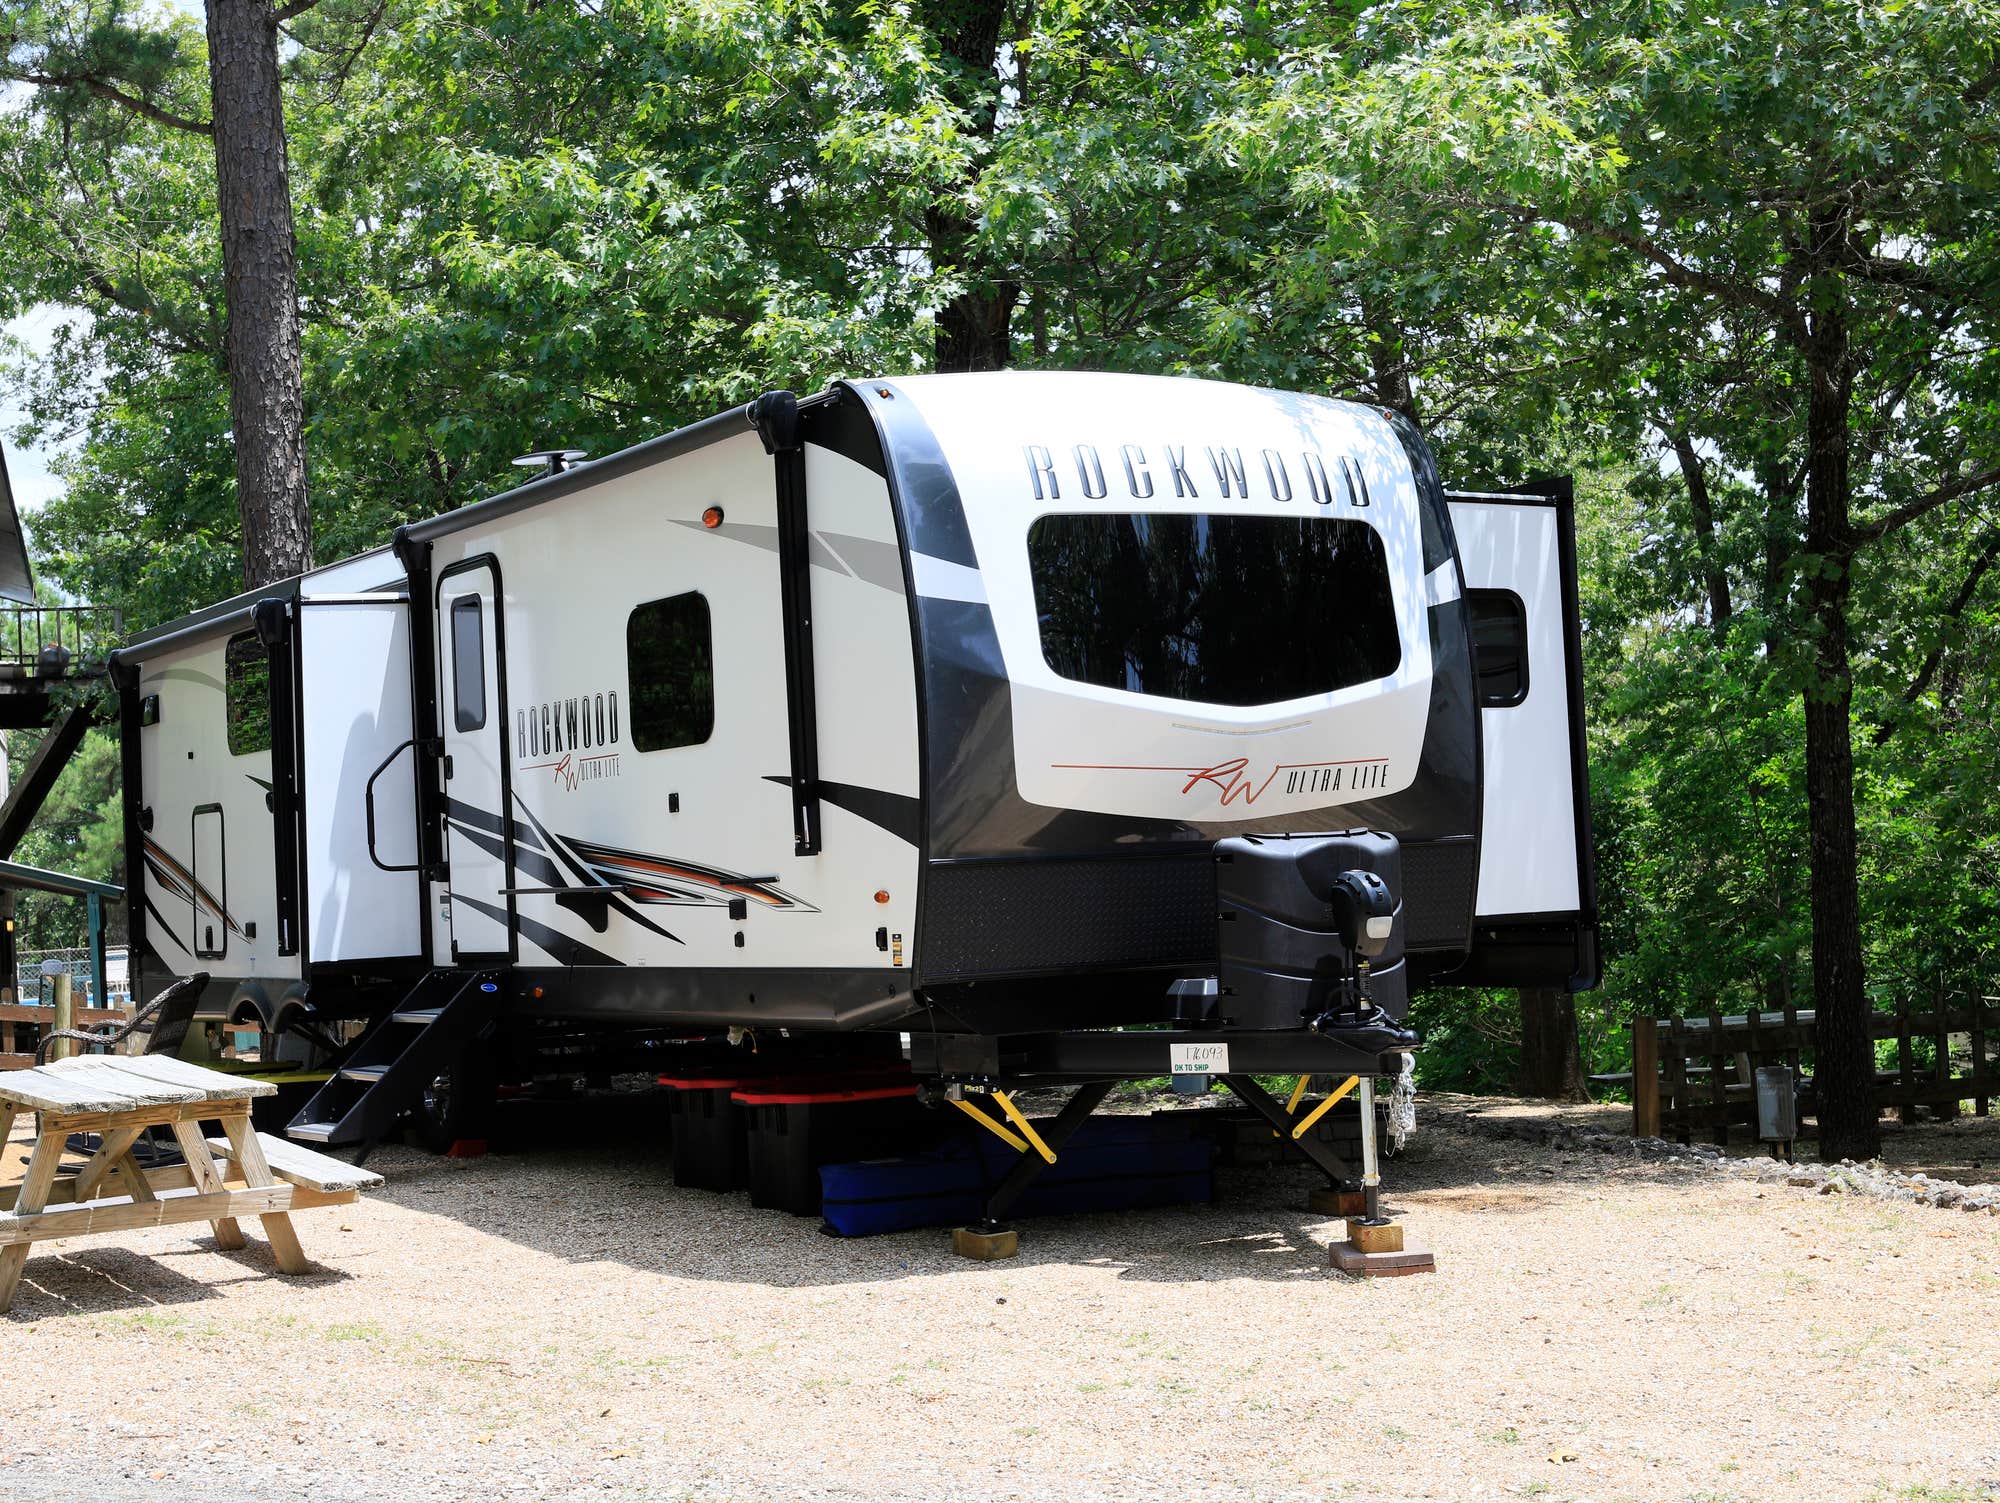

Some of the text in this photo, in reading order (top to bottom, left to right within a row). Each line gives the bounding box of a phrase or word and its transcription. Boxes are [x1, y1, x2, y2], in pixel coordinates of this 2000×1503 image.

[1023, 444, 1371, 507] ROCKWOOD
[517, 691, 618, 758] ROCKWOOD
[581, 761, 601, 781] ULTRA
[604, 758, 620, 777] LITE
[1286, 767, 1342, 795] ULTRA
[1351, 764, 1388, 789] LITE
[1194, 1063, 1209, 1071] SHIP
